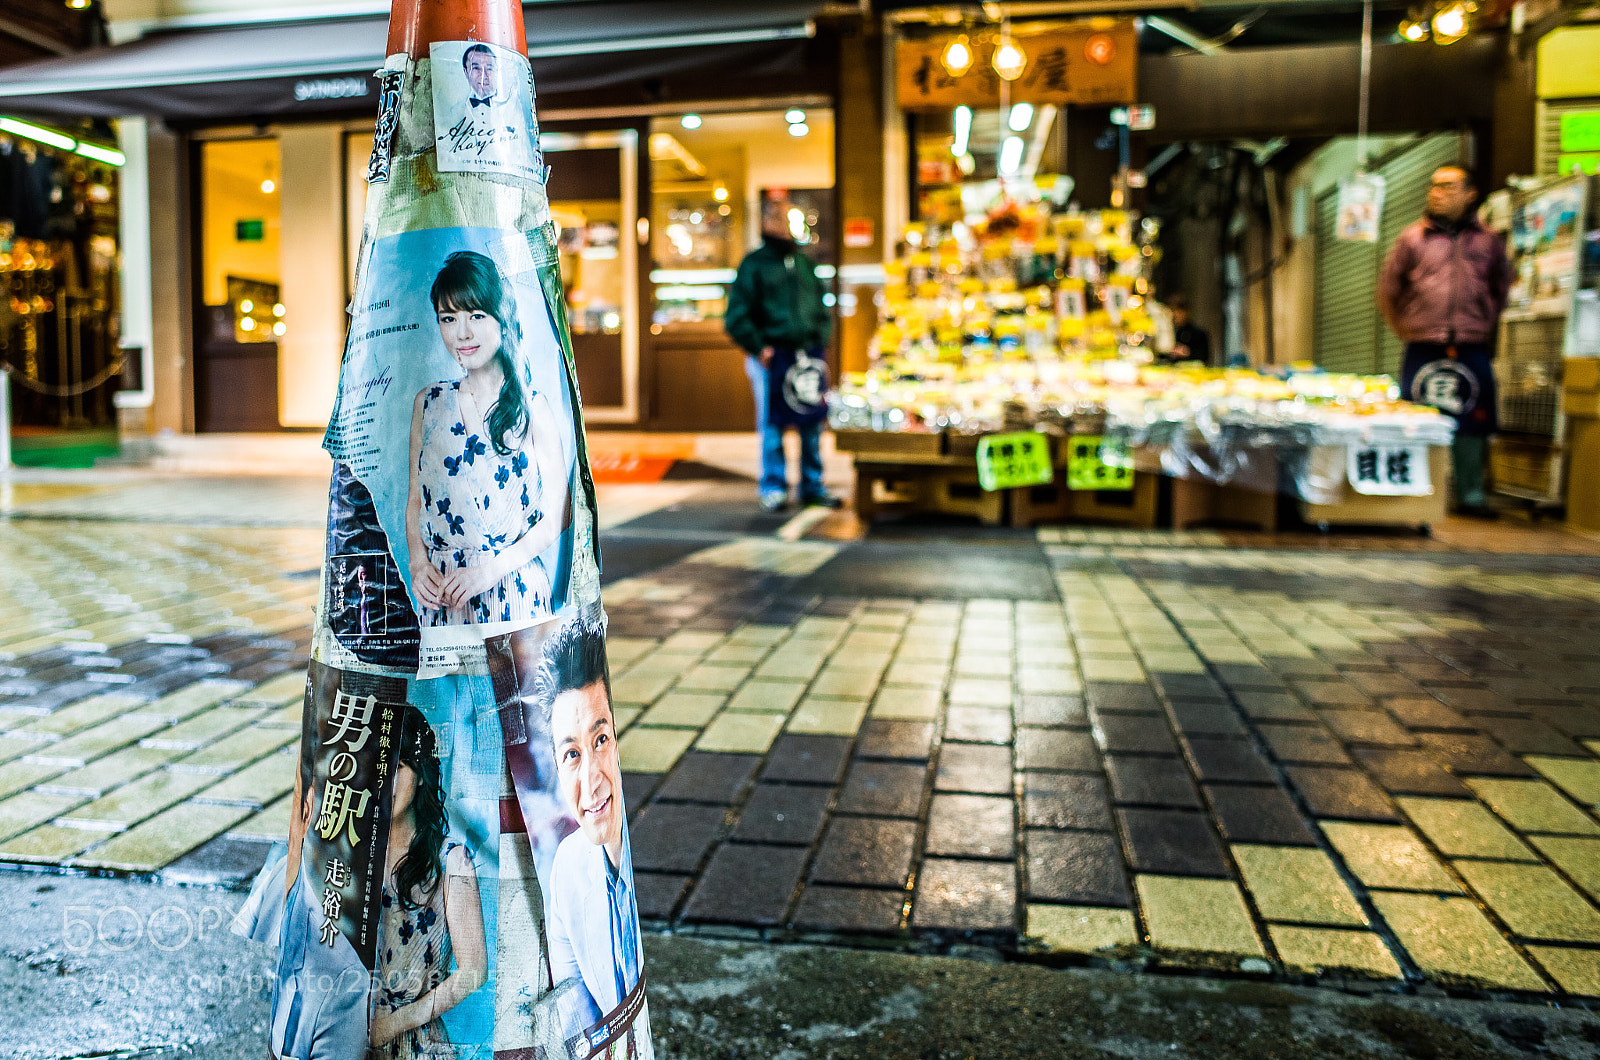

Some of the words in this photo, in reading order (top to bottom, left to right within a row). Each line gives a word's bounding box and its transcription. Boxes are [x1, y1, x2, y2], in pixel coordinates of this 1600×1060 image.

[314, 688, 377, 848] 男の駅
[320, 858, 345, 947] 走裕介
